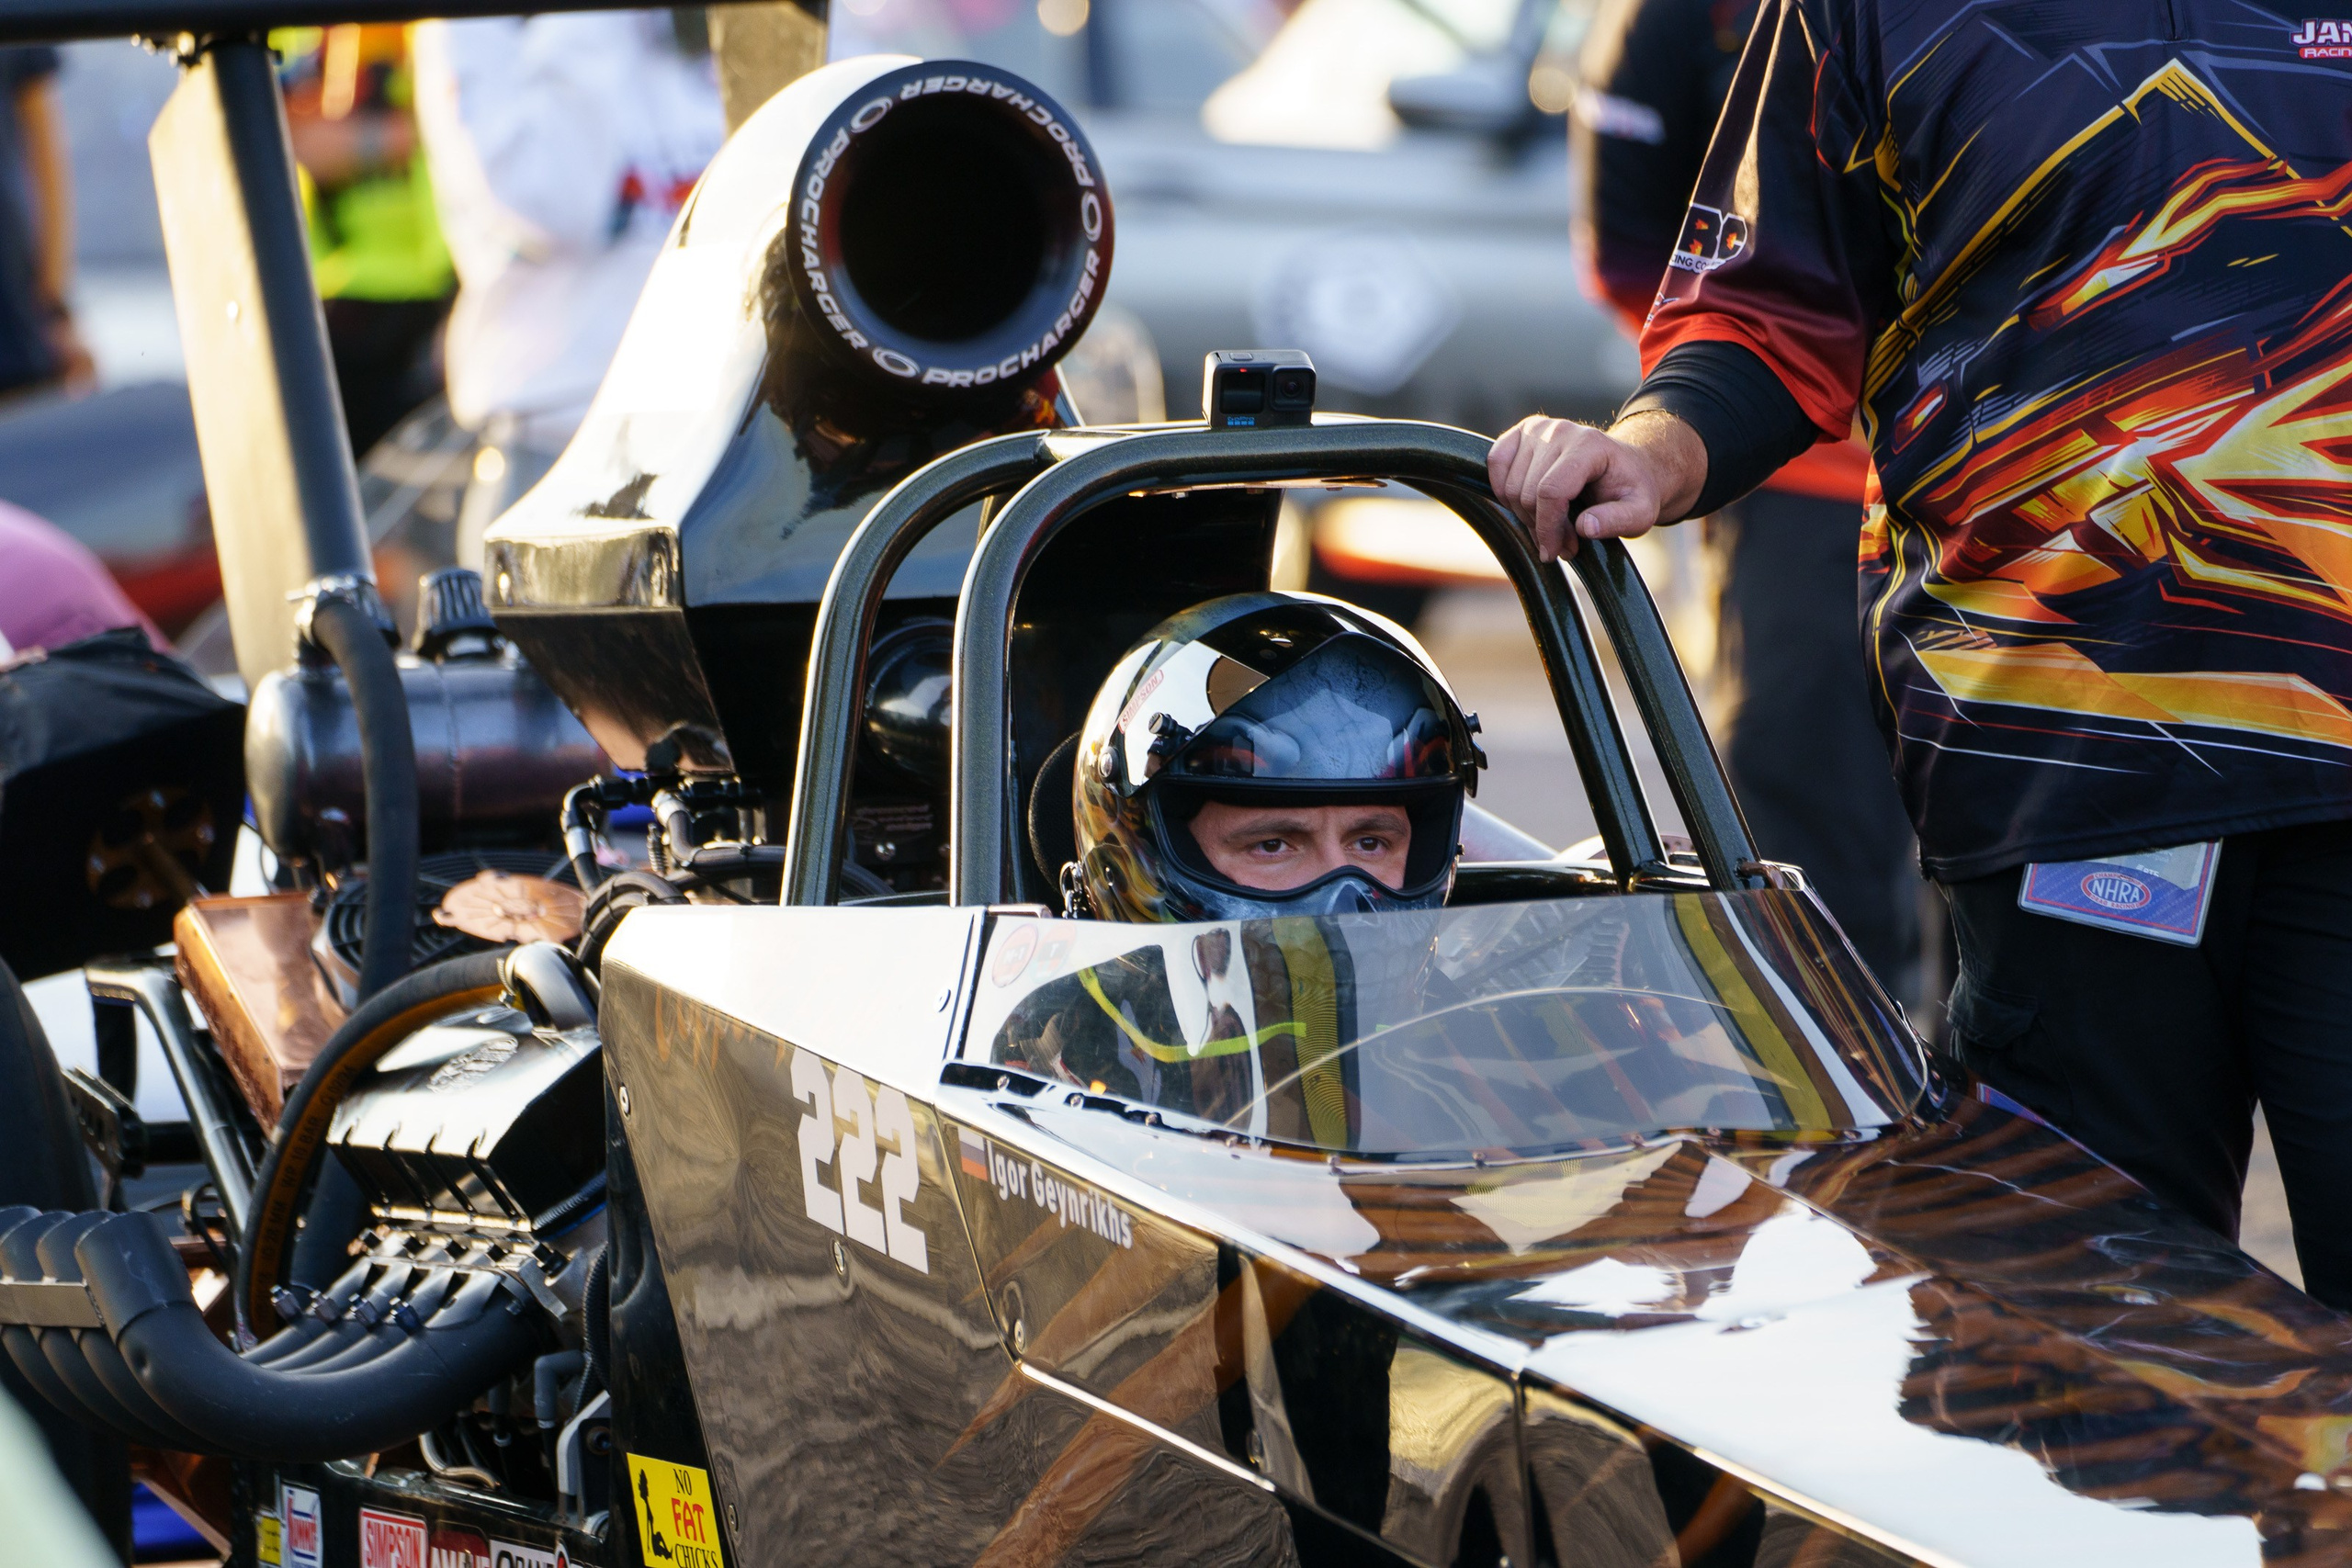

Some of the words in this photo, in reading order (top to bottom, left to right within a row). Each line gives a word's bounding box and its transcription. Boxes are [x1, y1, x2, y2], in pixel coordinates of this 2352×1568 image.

[900, 75, 1095, 187] PROCHARGER
[800, 127, 869, 350] PROCHARGER
[922, 251, 1101, 389] PROCHARGER
[1122, 676, 1159, 727] SIMPSON
[2092, 878, 2140, 903] NHRA
[790, 1046, 929, 1275] 222
[987, 1140, 1027, 1201] Igor
[1031, 1161, 1132, 1249] Geynrikhs
[673, 1468, 692, 1495] NO
[367, 1520, 422, 1568] SIMPSON
[671, 1497, 706, 1543] FAT
[674, 1544, 718, 1568] CHICKS
